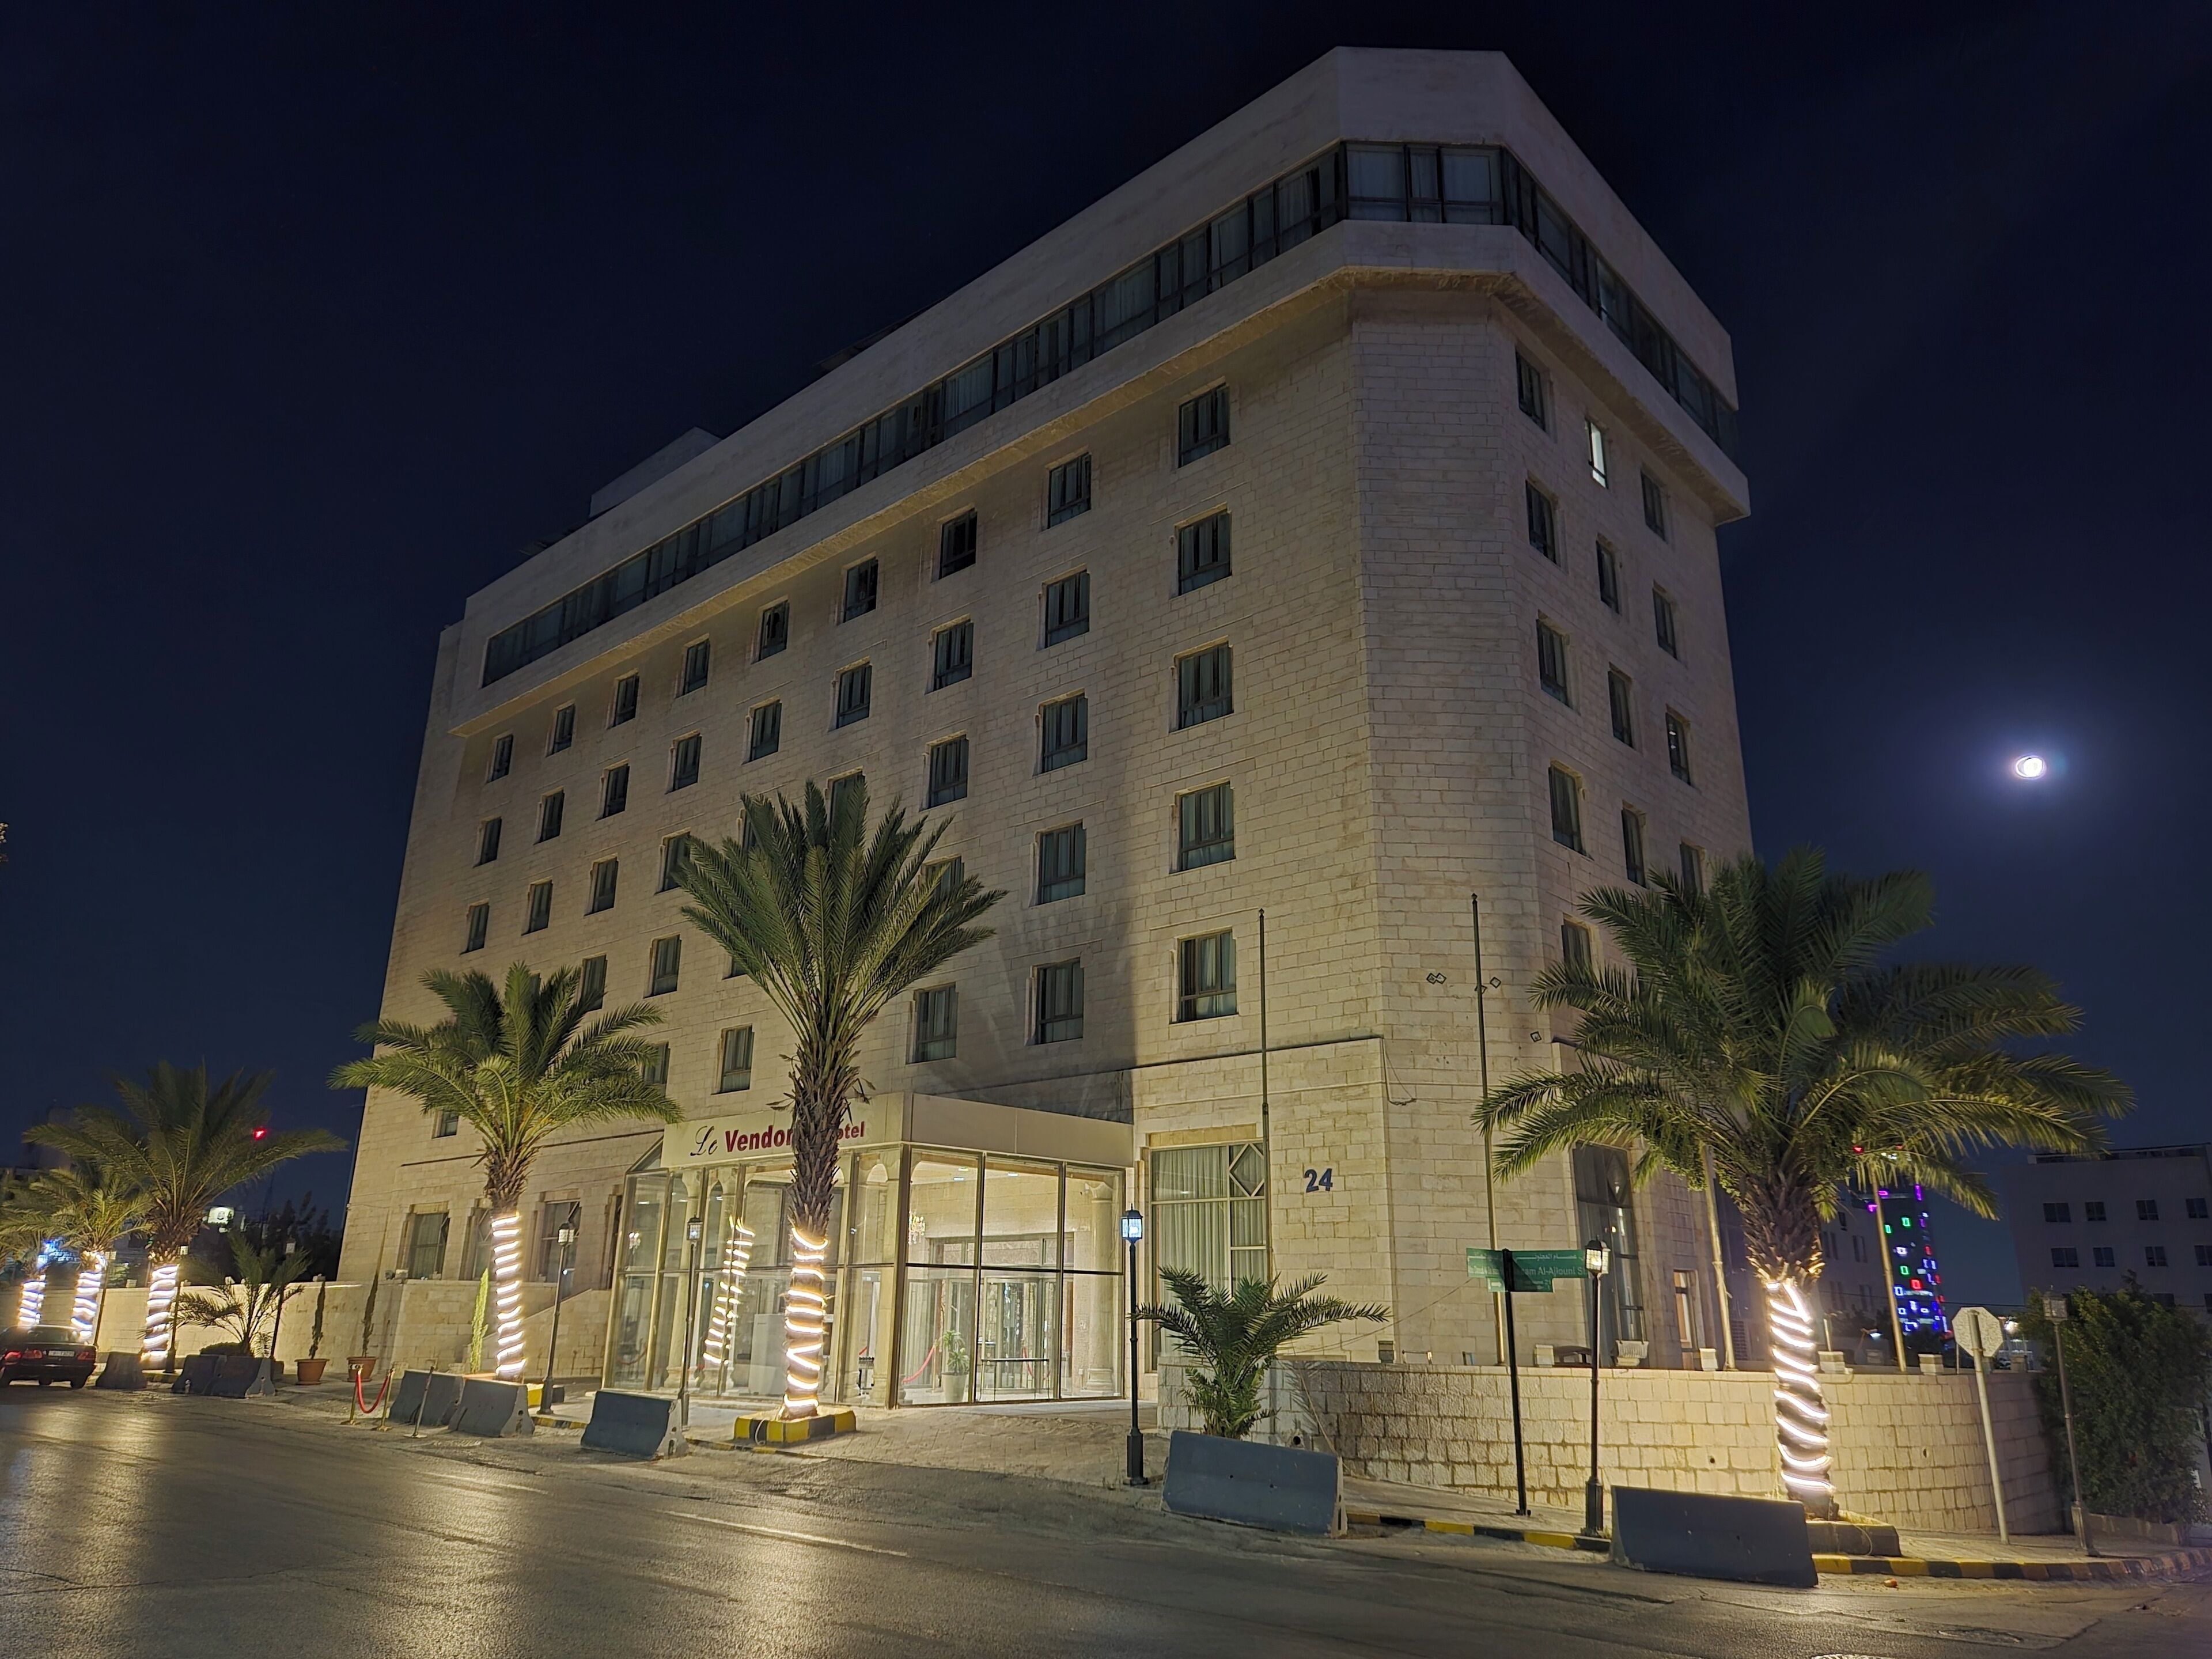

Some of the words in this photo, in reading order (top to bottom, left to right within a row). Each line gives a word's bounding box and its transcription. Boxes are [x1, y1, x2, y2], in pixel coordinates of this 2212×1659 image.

[690, 1126, 718, 1156] Le
[837, 1121, 865, 1139] otel
[1303, 1168, 1333, 1193] 24
